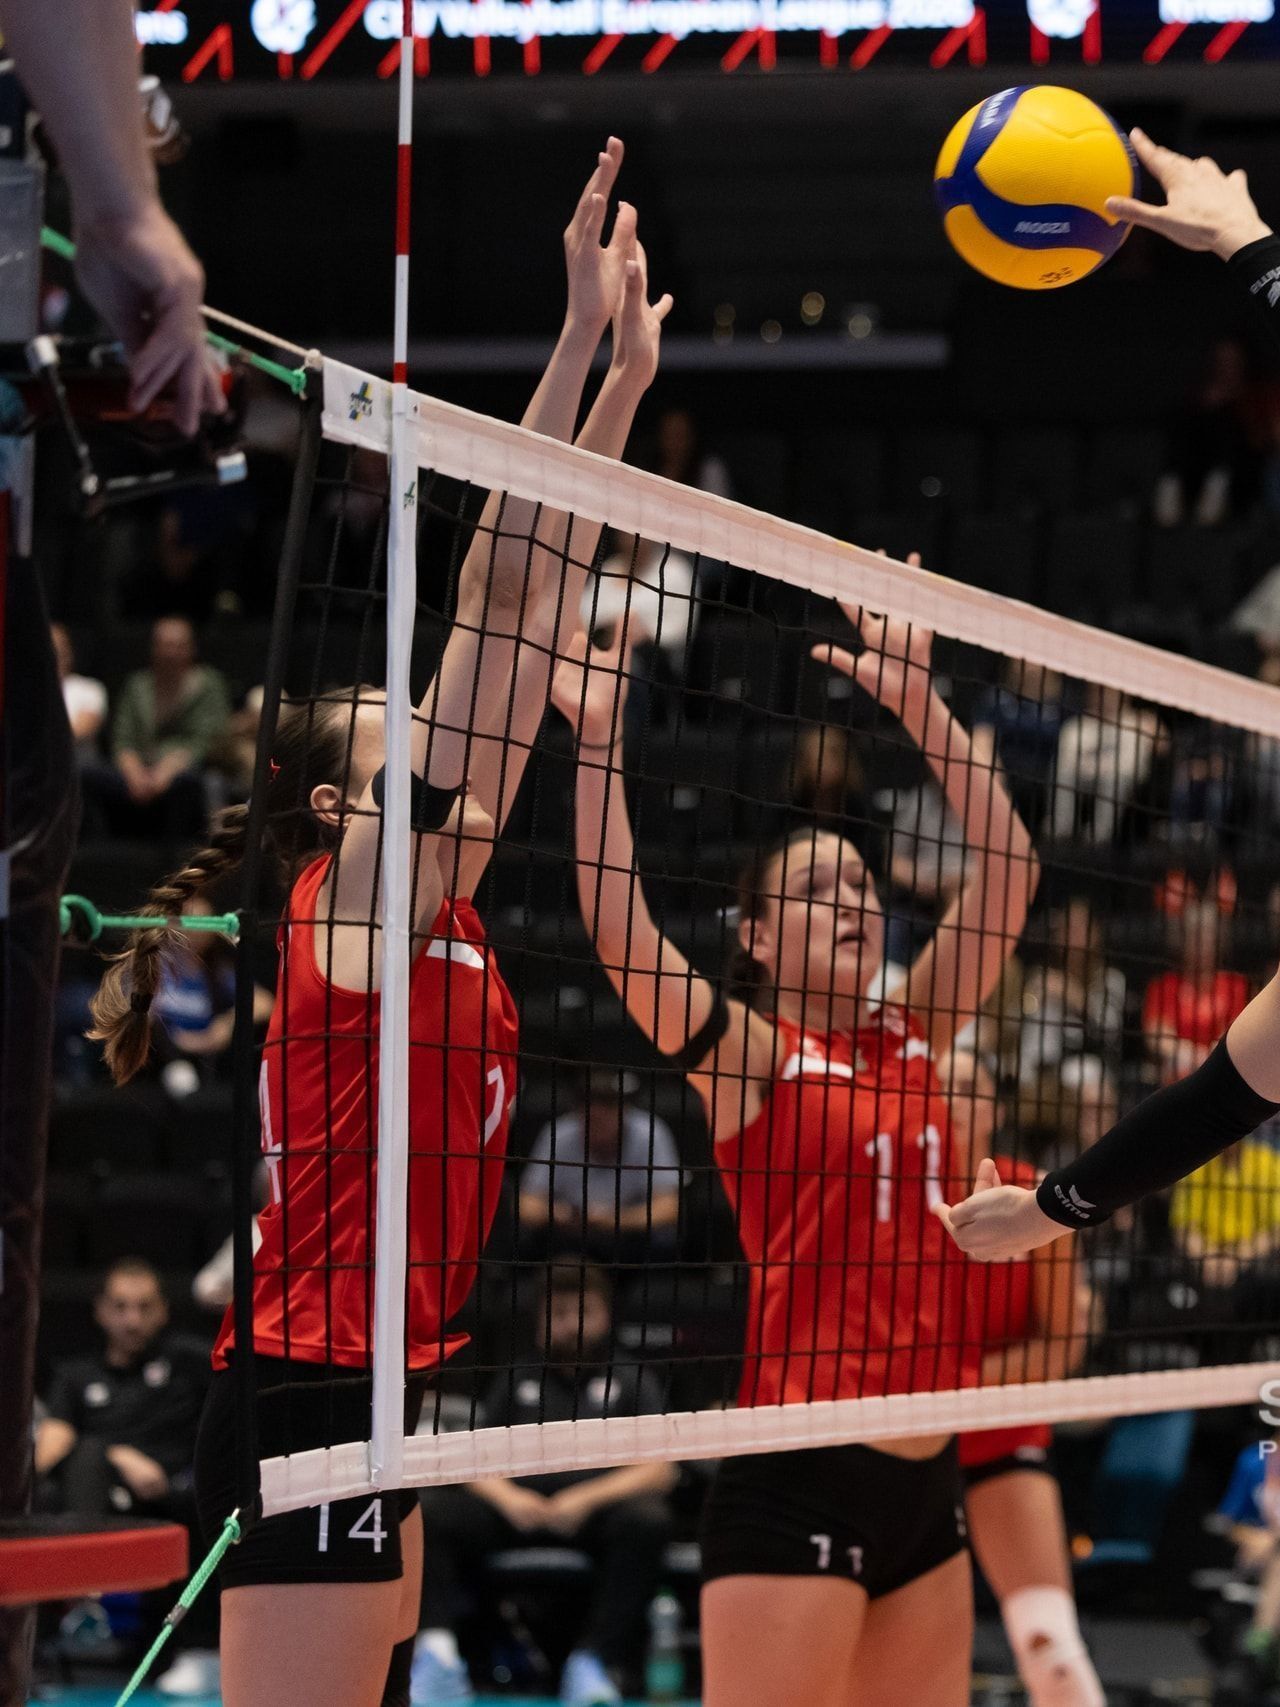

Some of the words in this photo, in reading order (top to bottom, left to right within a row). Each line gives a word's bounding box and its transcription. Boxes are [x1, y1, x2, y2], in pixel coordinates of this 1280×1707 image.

[865, 1123, 944, 1222] 11
[1054, 1184, 1090, 1219] erima
[318, 1498, 388, 1553] 14
